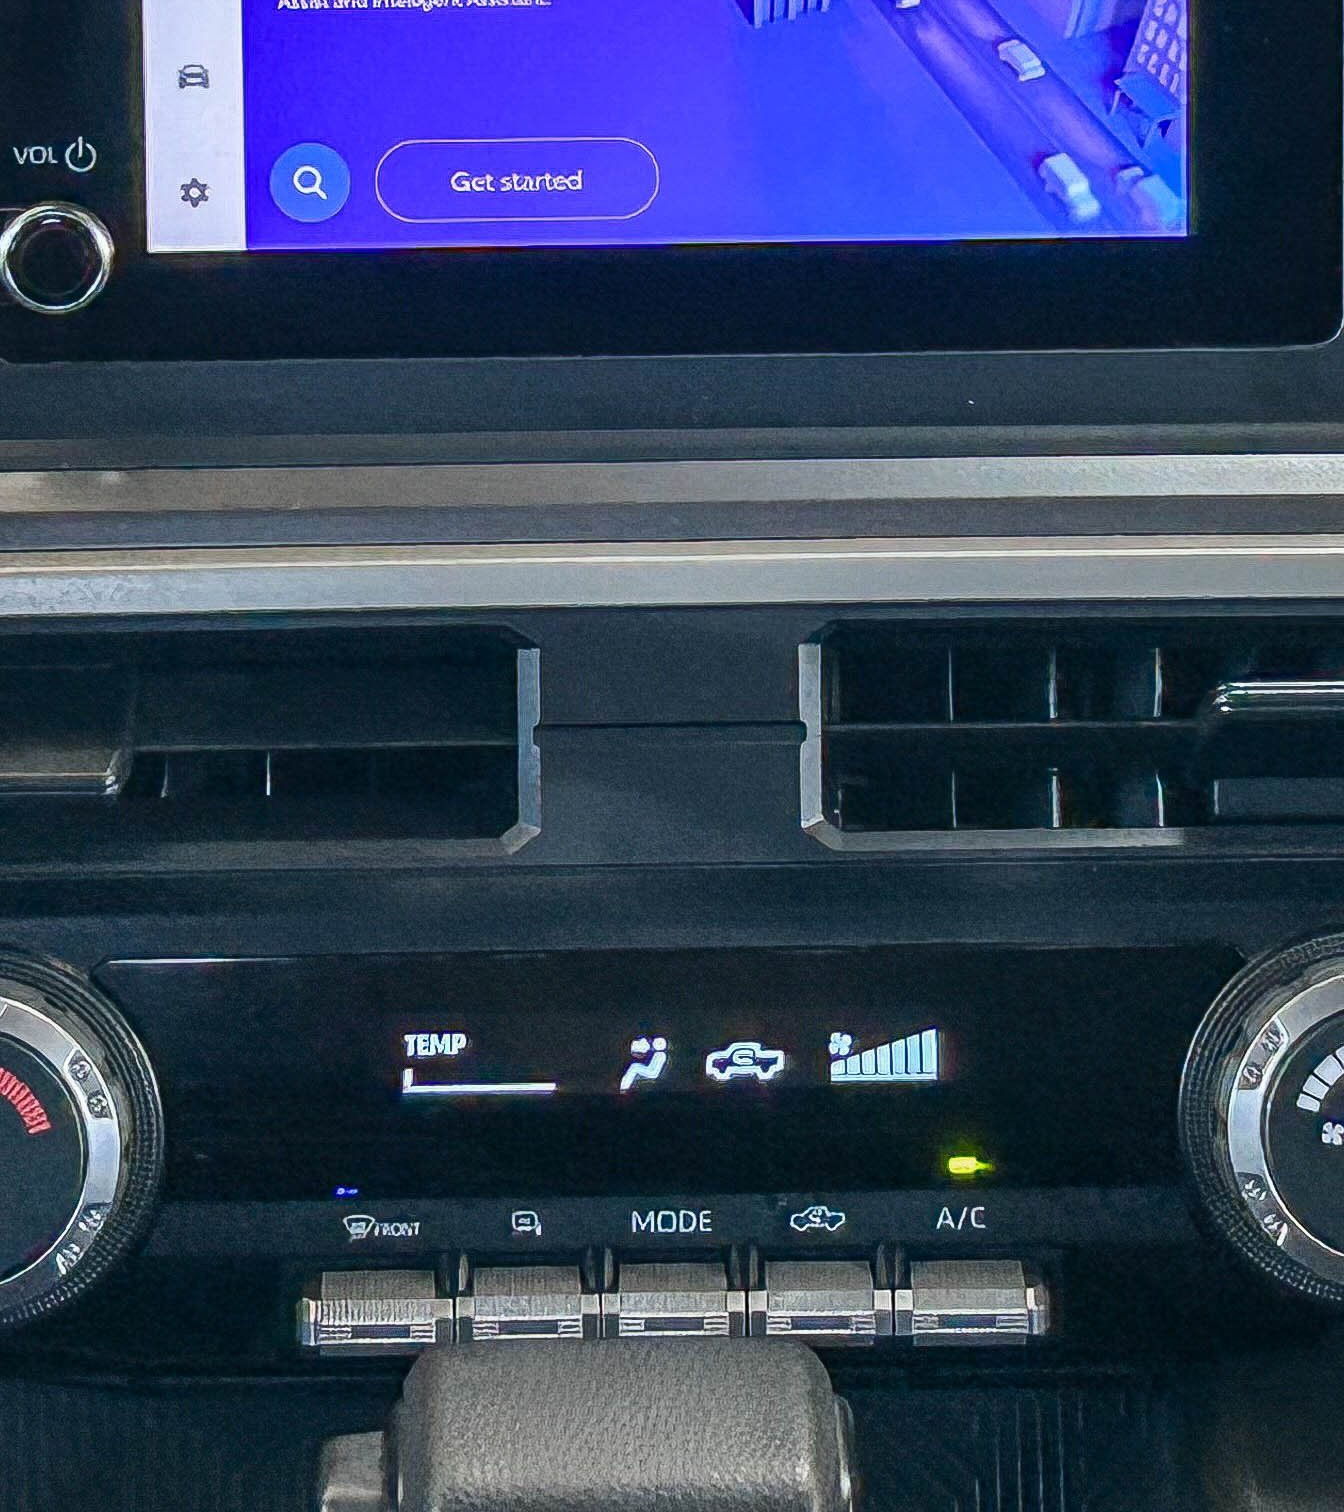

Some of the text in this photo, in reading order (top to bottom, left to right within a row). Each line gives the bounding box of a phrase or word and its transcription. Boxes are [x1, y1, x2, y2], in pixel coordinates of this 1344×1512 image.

[12, 146, 59, 165] VOL
[450, 169, 584, 192] Get started
[404, 1033, 467, 1057] TEMP
[374, 1222, 421, 1237] FRONT
[631, 1210, 713, 1234] MODE
[936, 1206, 987, 1231] A/C
